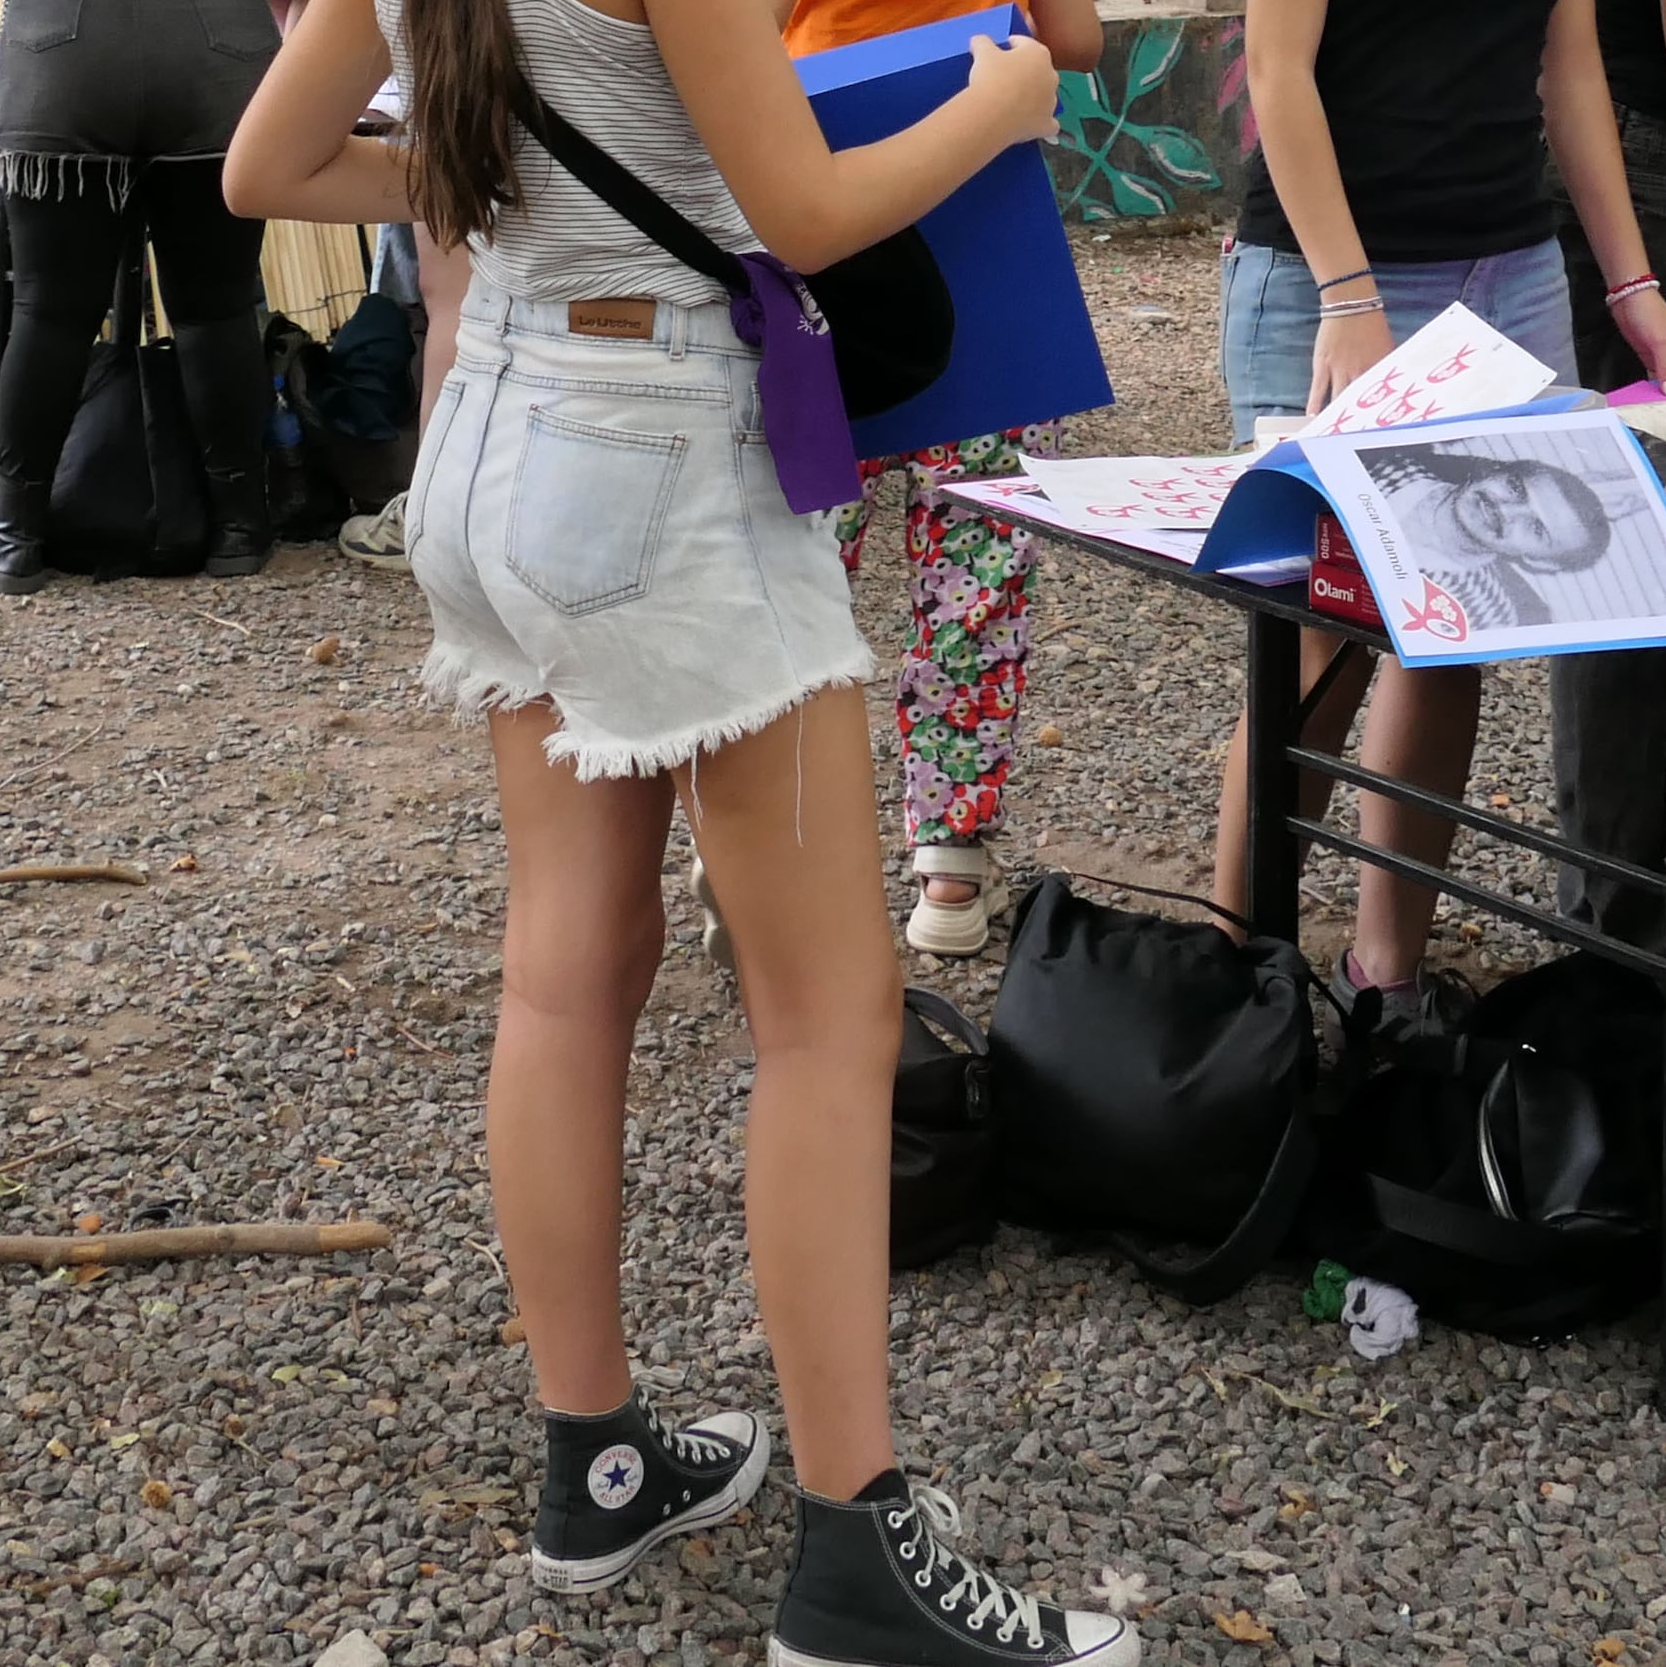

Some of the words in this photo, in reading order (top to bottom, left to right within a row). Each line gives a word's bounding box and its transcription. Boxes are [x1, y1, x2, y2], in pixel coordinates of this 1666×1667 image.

[1357, 493, 1382, 525] Oscar
[1376, 527, 1409, 580] Adamoli
[1314, 577, 1354, 603] Olami
